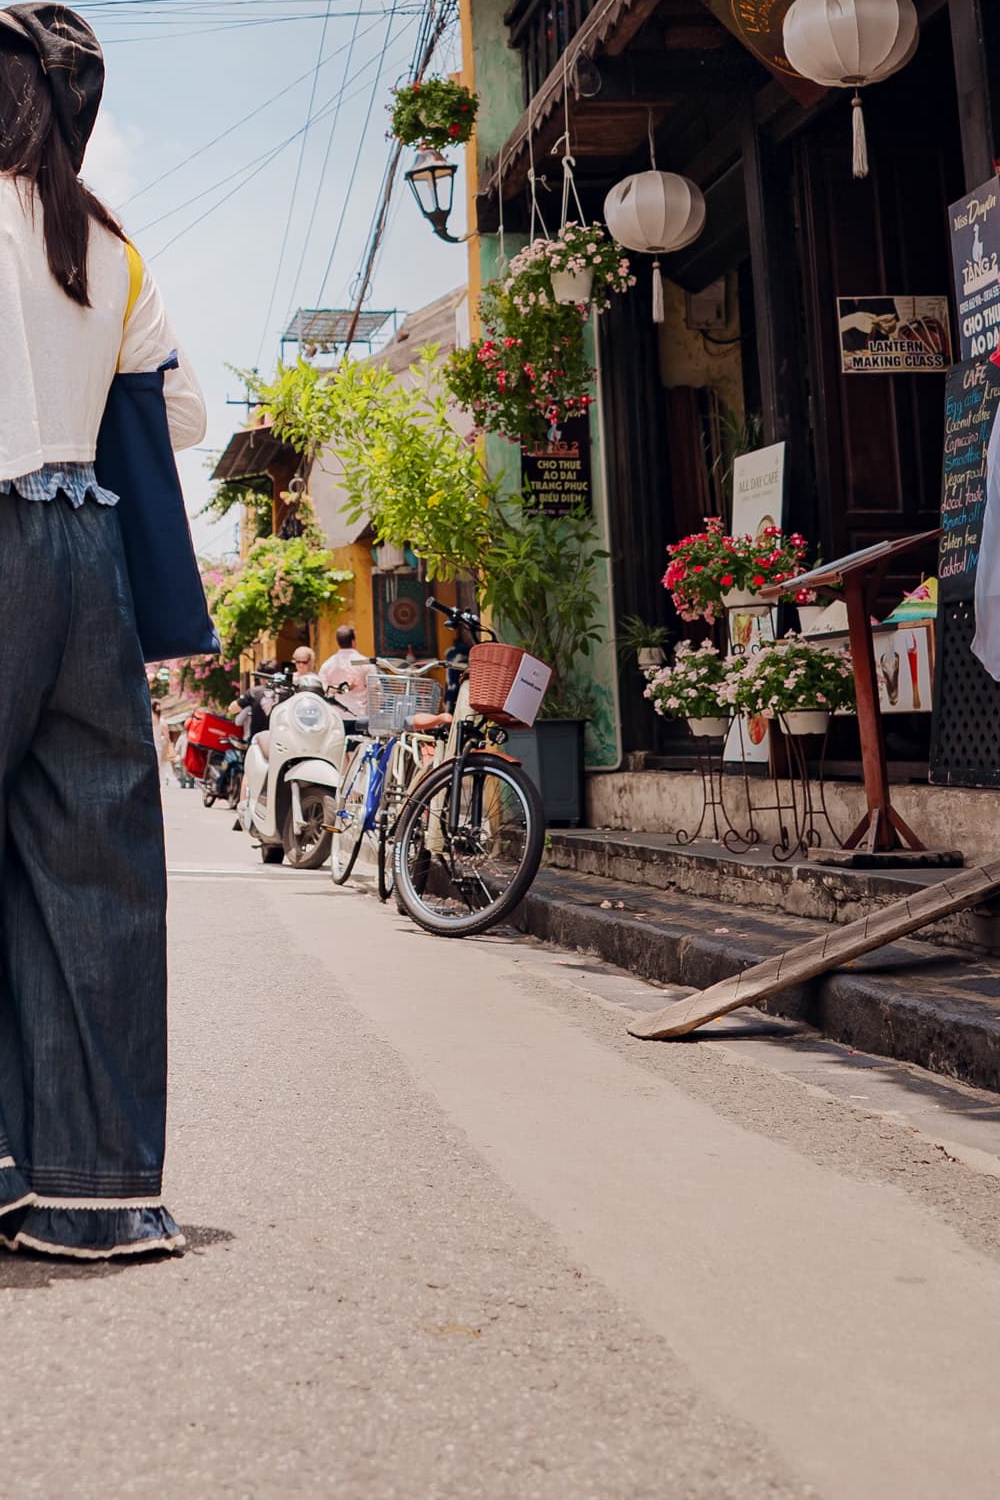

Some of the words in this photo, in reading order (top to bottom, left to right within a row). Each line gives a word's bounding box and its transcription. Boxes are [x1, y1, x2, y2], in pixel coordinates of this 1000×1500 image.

[963, 312, 983, 338] CHO
[869, 340, 924, 353] LANTERN
[852, 355, 901, 368] MAKING
[904, 355, 943, 368] CLASS
[537, 460, 557, 469] CHO
